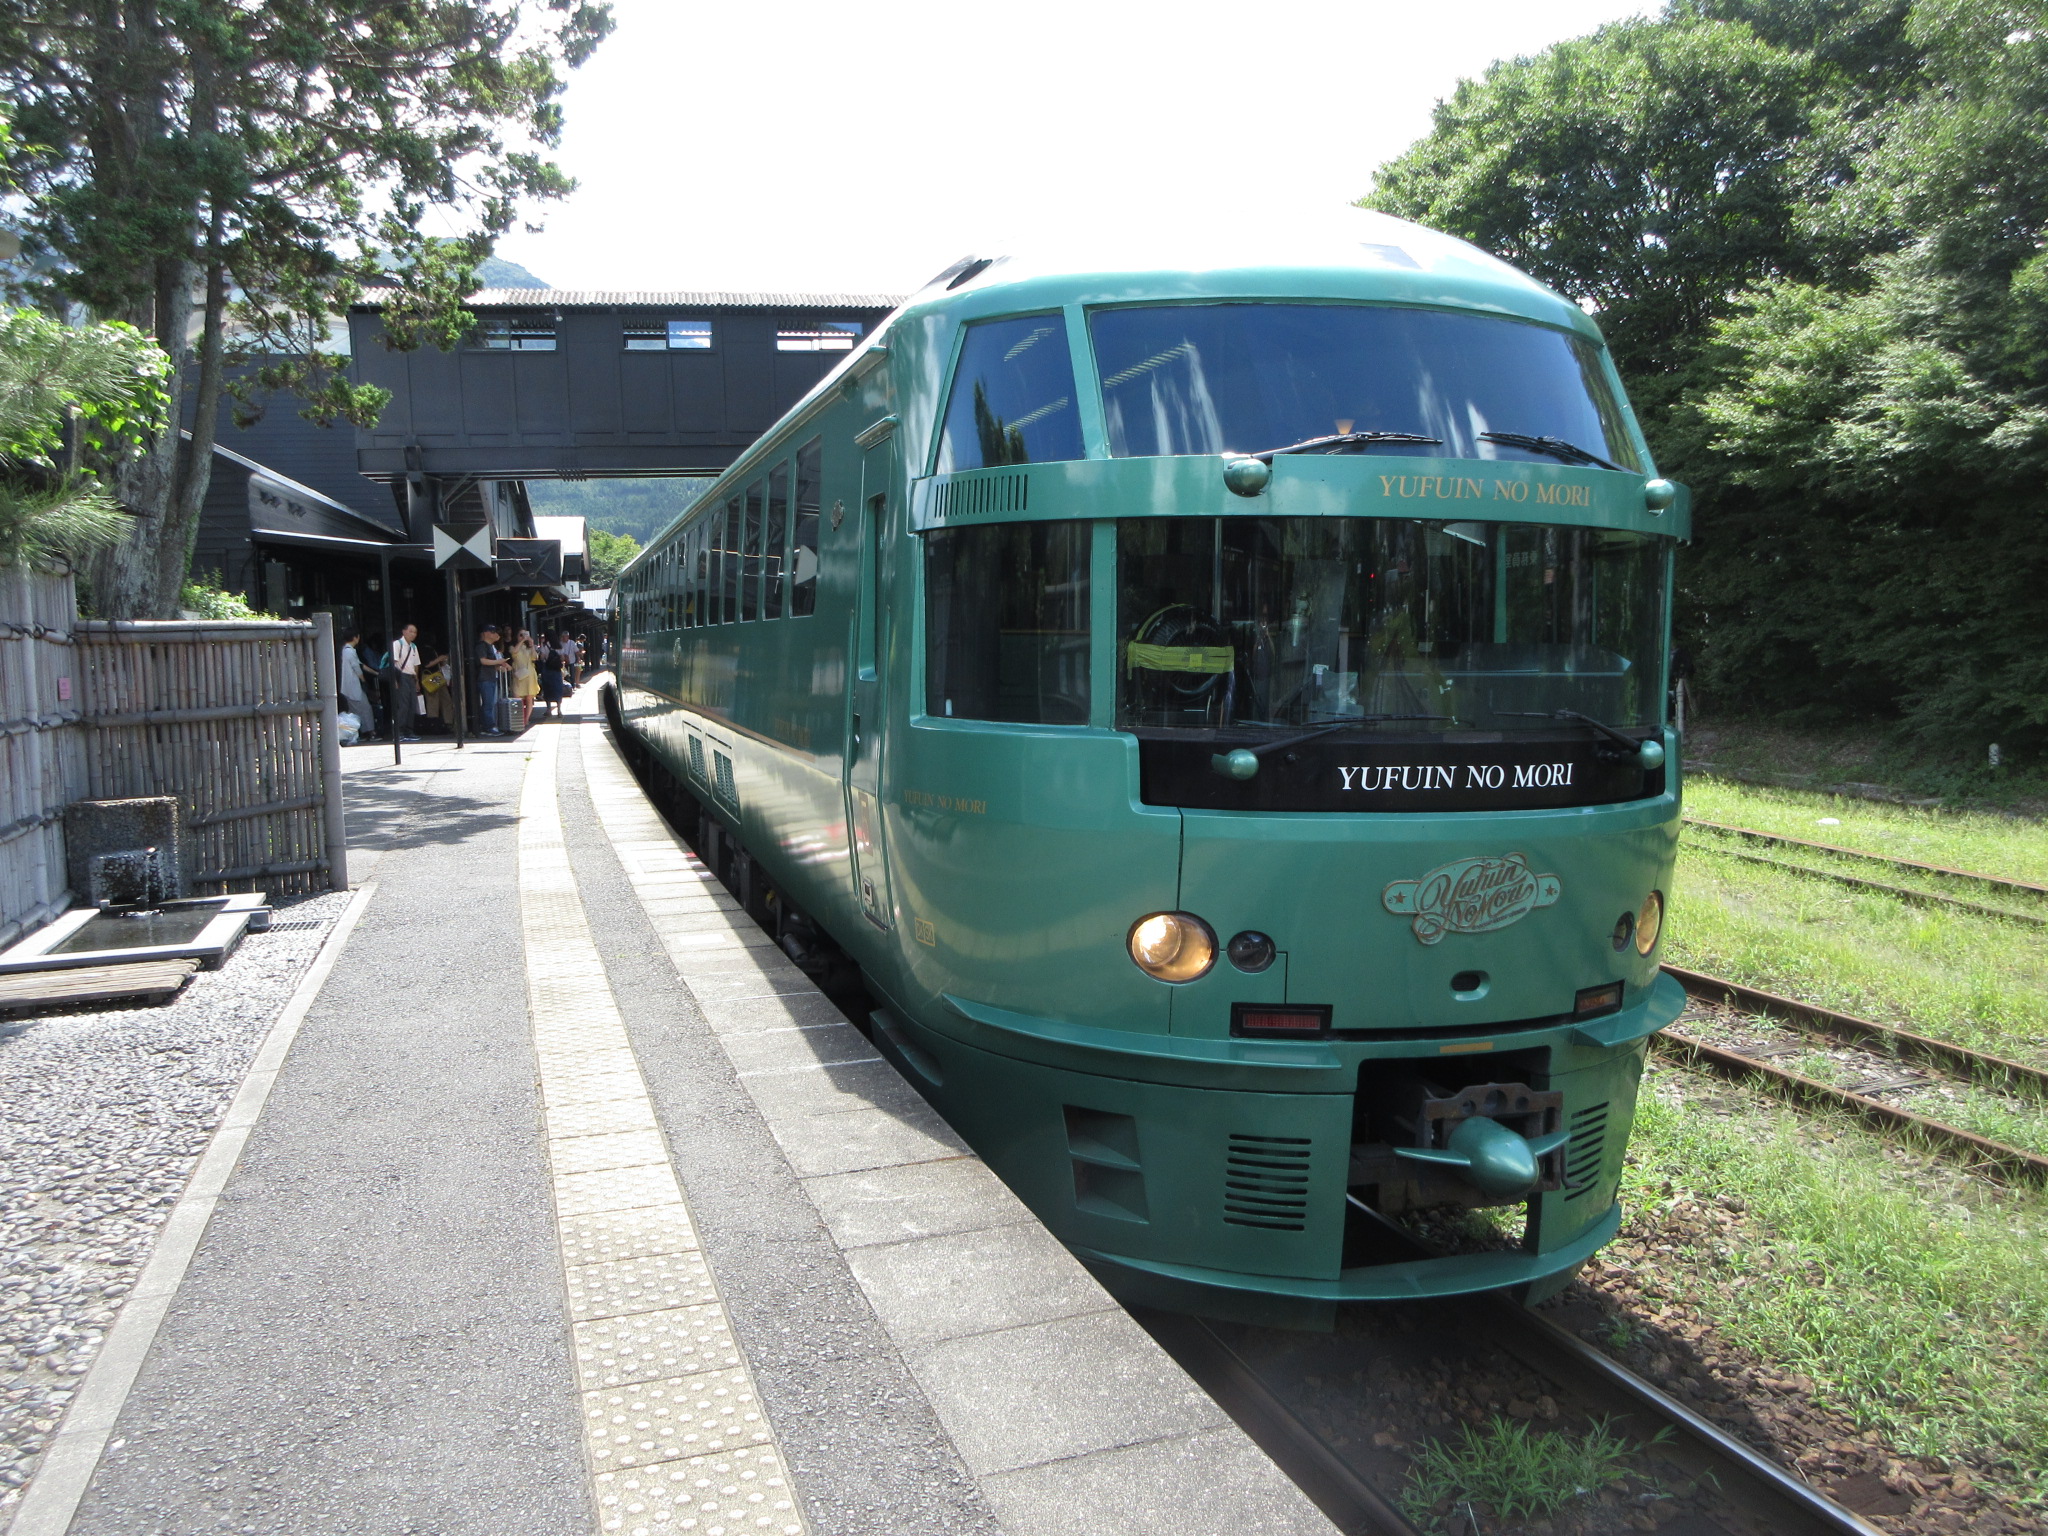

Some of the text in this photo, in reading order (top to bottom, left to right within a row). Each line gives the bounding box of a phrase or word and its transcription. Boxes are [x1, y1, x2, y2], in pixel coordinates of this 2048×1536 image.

[1379, 475, 1590, 507] YUFUIN NO MORI
[1338, 762, 1573, 791] YUFUIN NO MORI
[937, 795, 953, 809] NO
[955, 797, 987, 814] MORI
[1421, 862, 1520, 921] Yufuin
